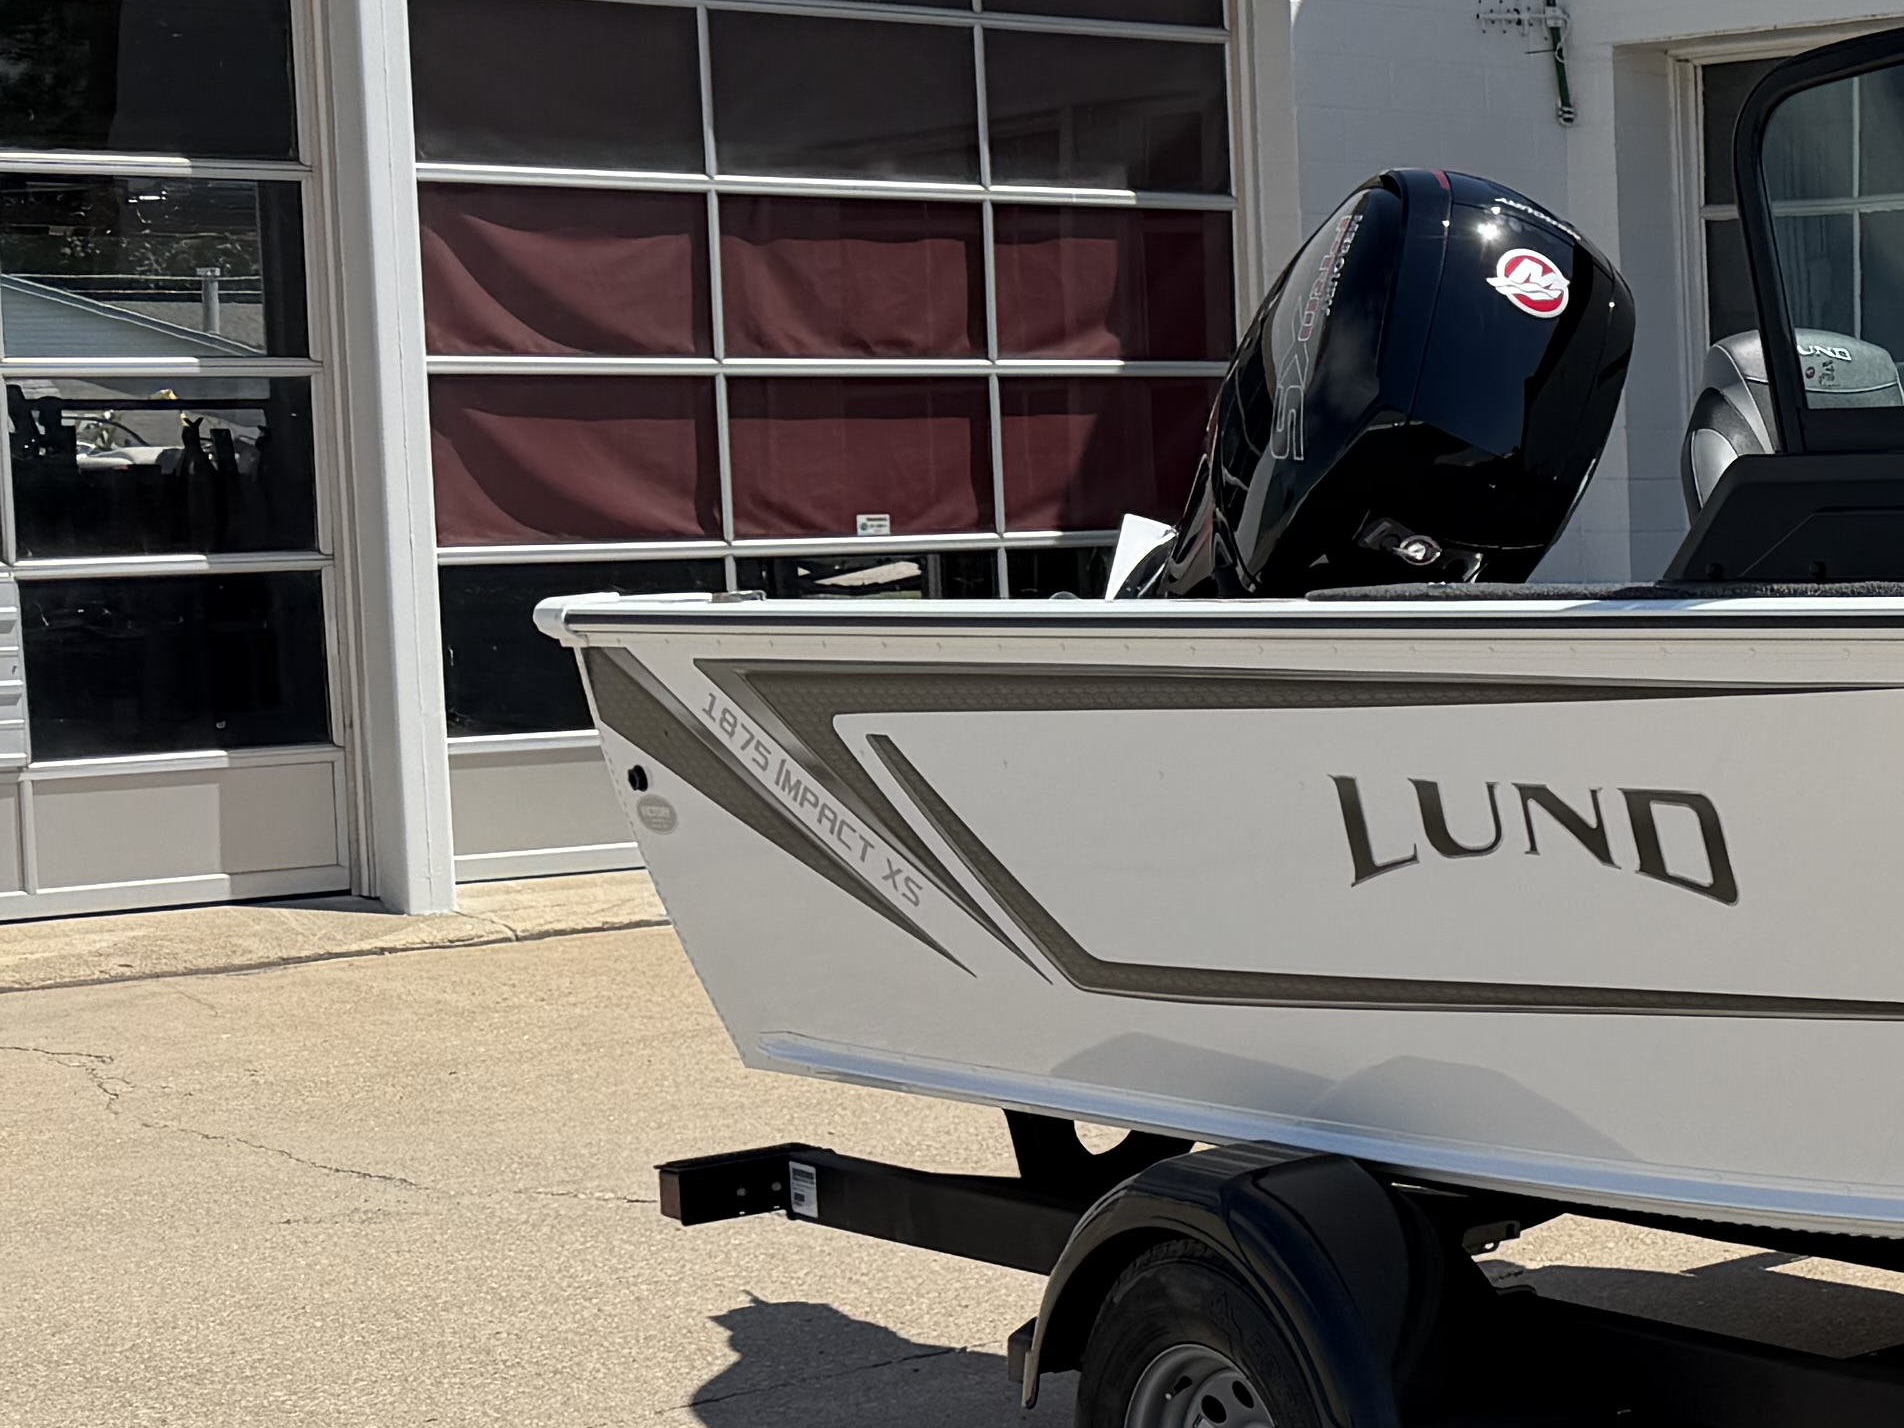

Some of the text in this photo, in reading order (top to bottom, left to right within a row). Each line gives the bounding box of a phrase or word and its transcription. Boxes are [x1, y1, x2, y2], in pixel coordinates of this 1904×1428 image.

[1797, 344, 1853, 361] UND
[701, 691, 924, 908] 1875 IMPACT XS
[1329, 773, 1739, 907] LUND
